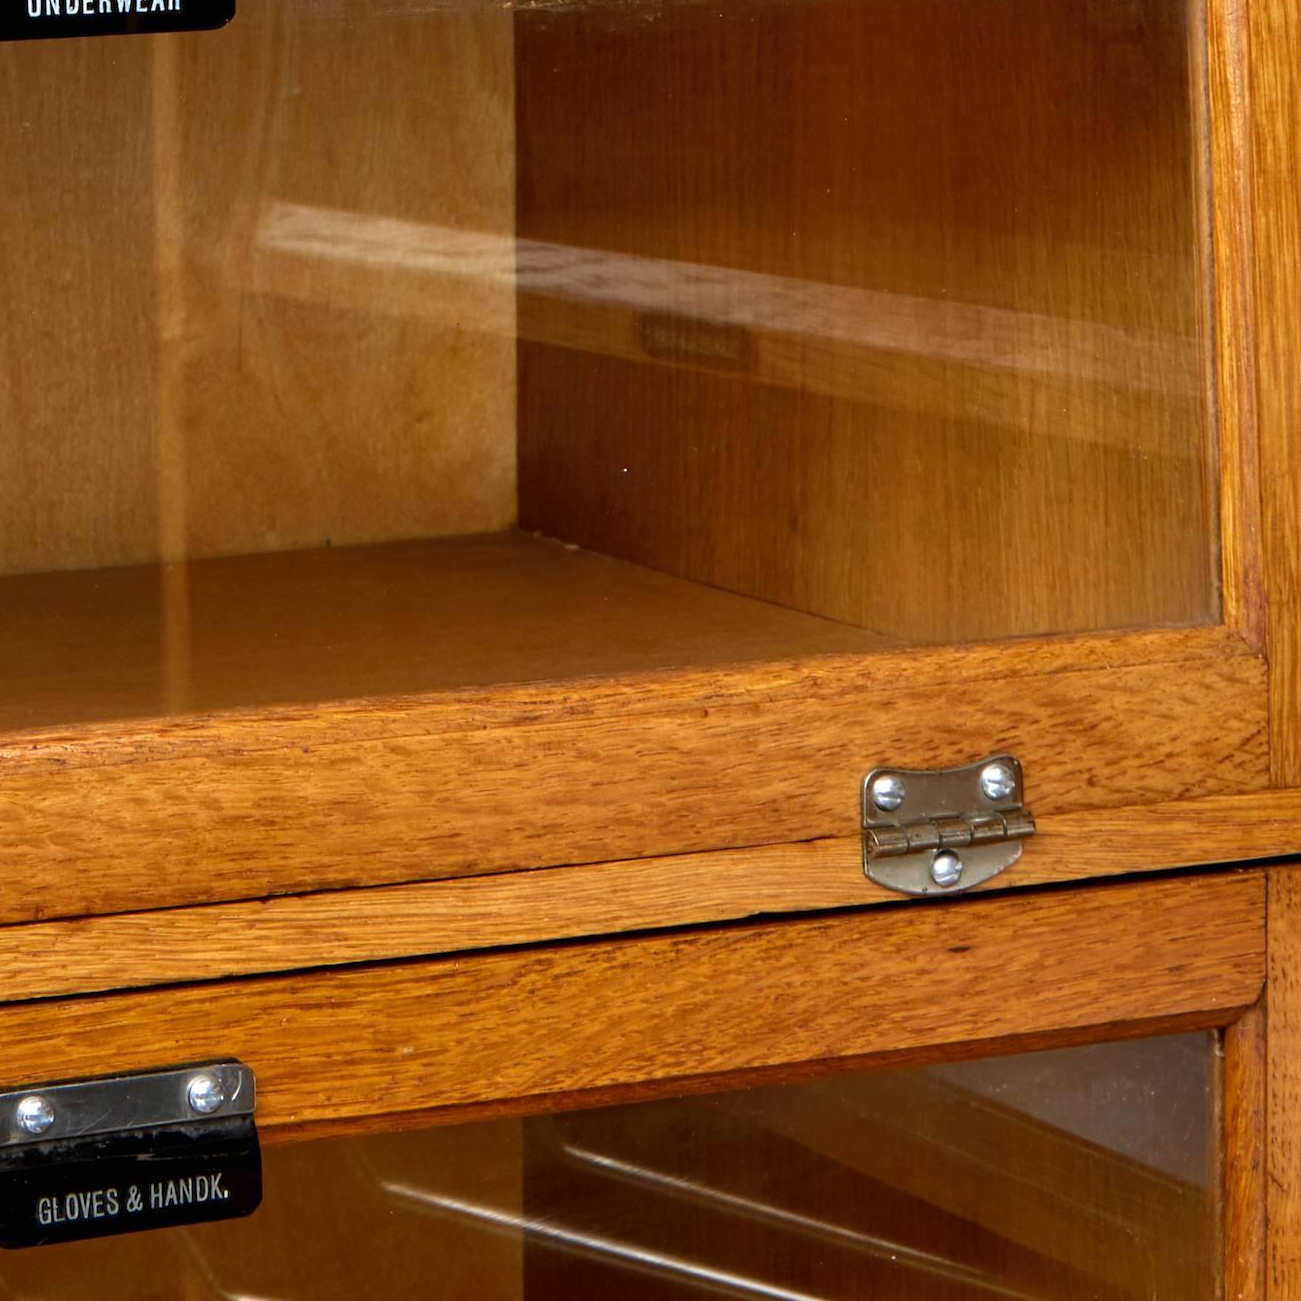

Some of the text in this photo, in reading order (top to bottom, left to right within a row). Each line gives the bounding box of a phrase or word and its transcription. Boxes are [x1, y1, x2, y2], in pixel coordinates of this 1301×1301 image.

[37, 1172, 229, 1226] GLOVES & HANDK.
